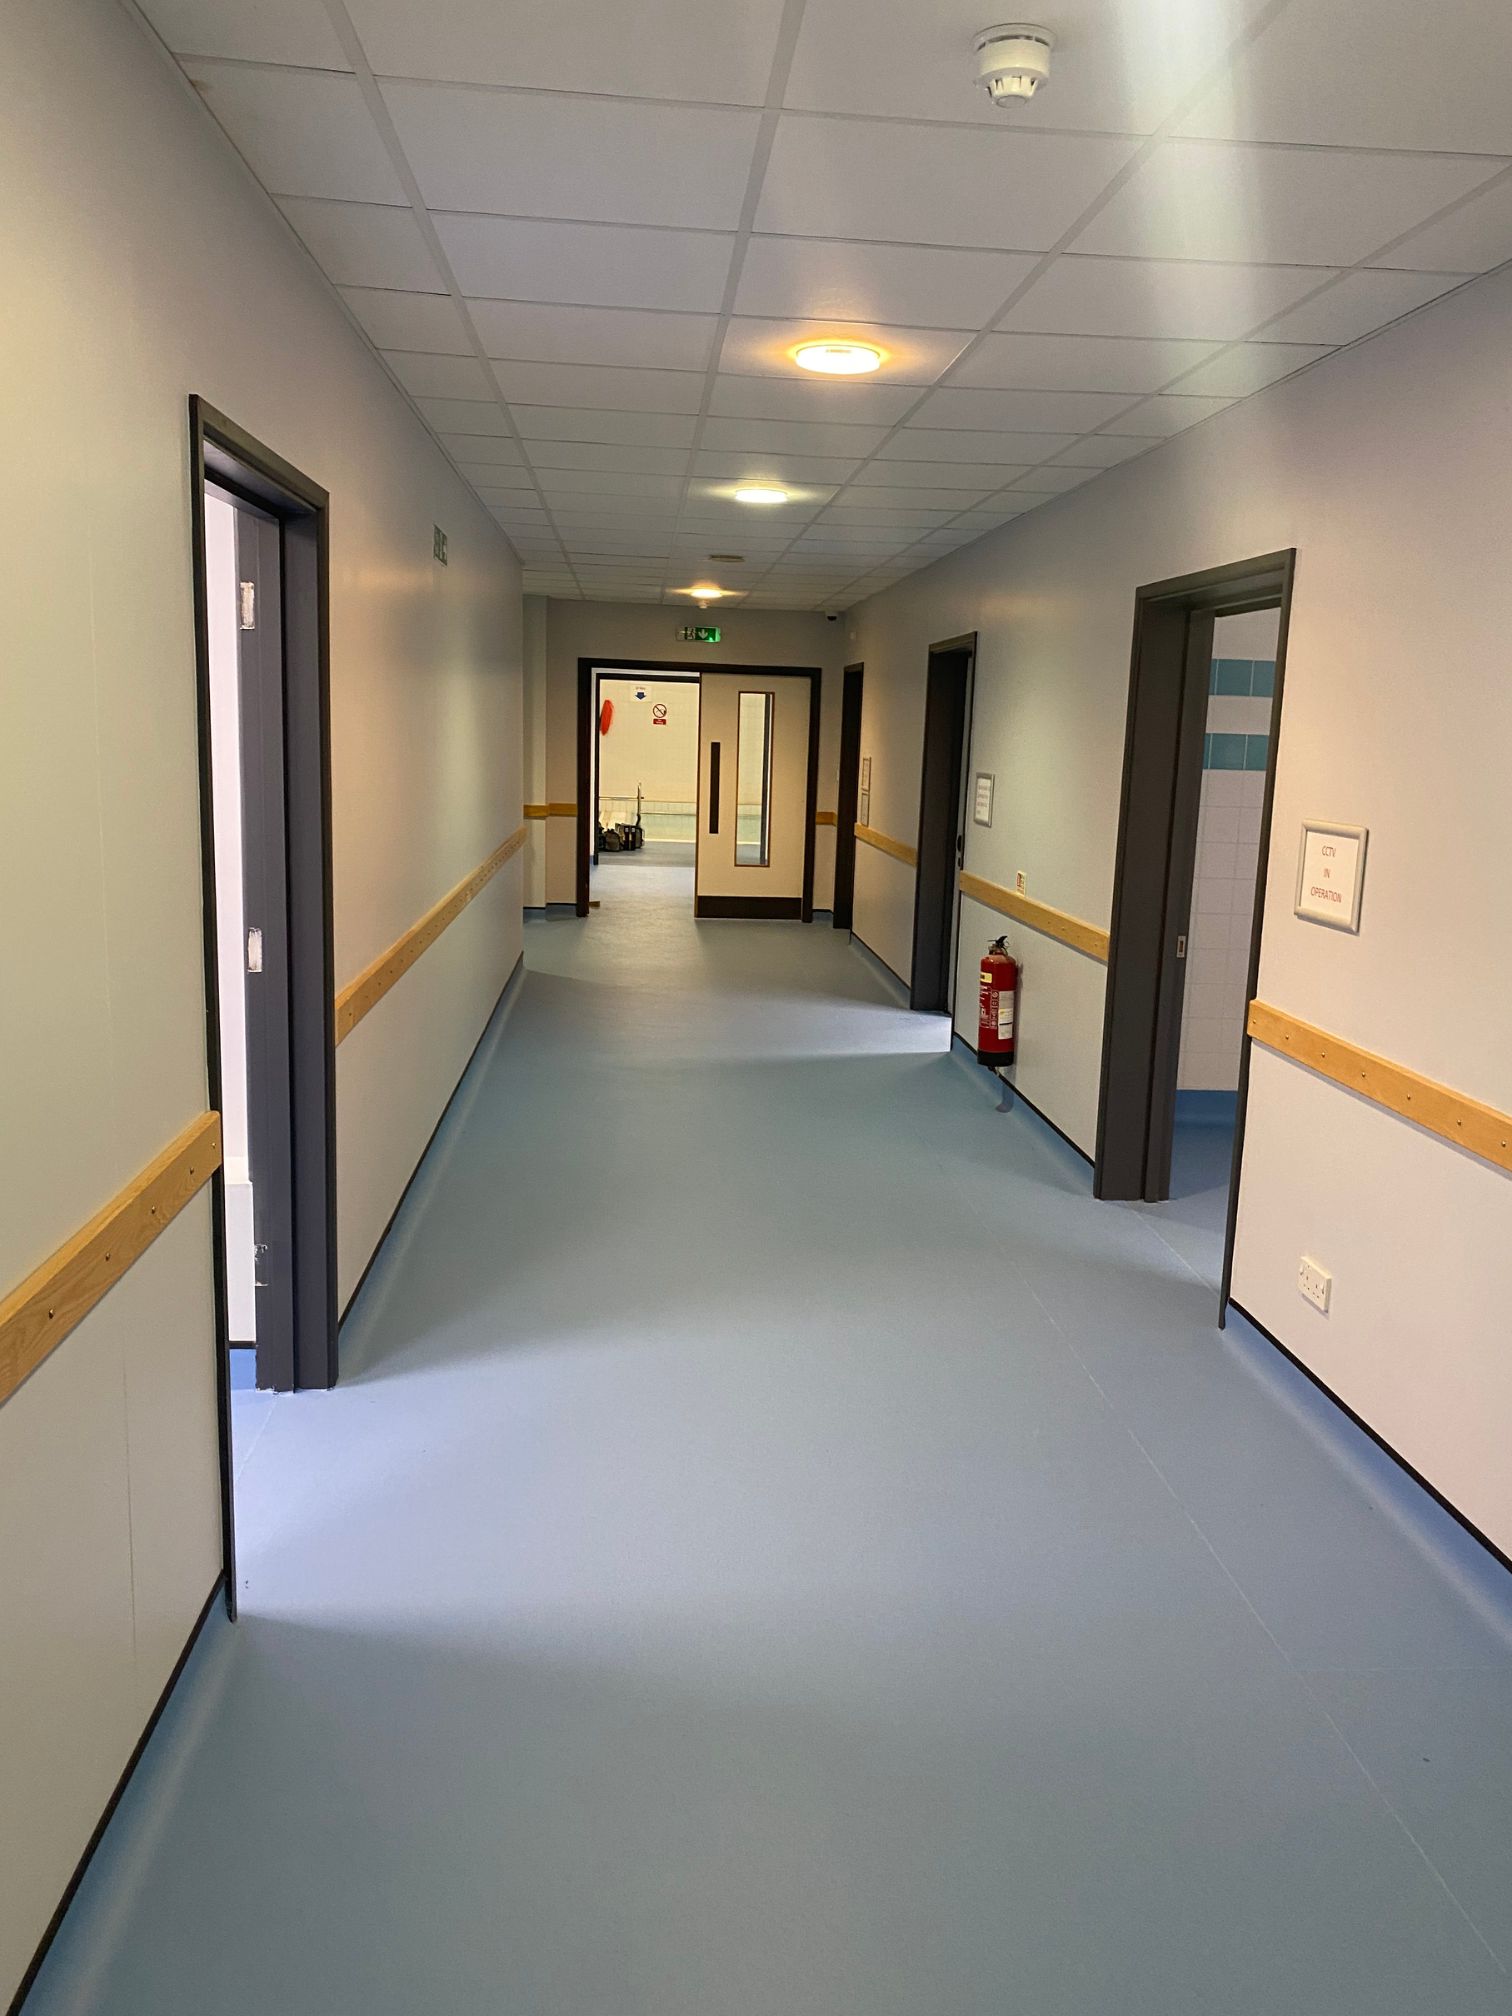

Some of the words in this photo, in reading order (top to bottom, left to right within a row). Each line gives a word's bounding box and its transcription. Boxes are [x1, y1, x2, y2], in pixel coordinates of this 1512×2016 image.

[1322, 845, 1337, 857] CCTV
[1323, 868, 1330, 878] IN
[1311, 886, 1342, 903] OPERATION
